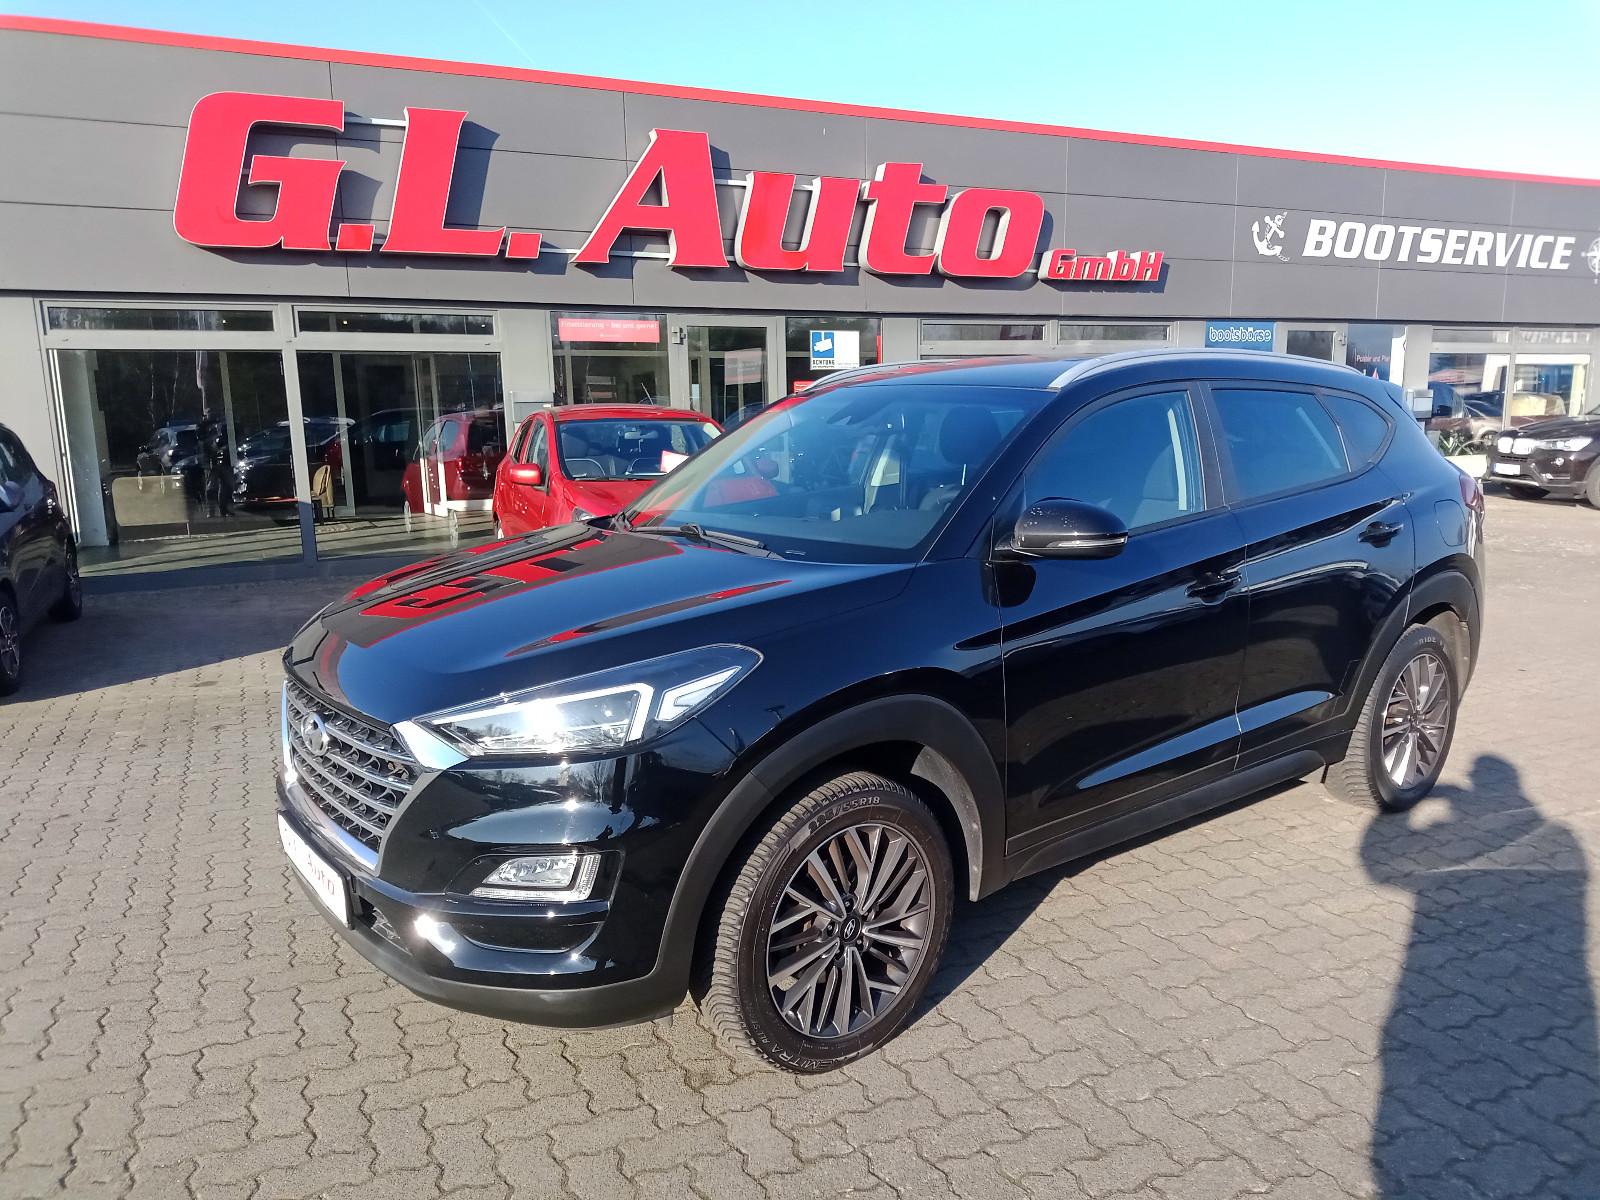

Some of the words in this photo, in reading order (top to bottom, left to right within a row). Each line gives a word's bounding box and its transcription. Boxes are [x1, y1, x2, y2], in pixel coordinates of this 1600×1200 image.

[173, 91, 542, 258] G.L.
[570, 128, 1044, 278] Auto
[1038, 248, 1164, 281] GmbH
[1302, 219, 1576, 270] BOOTSERVICE
[1209, 326, 1272, 342] bootsbörse
